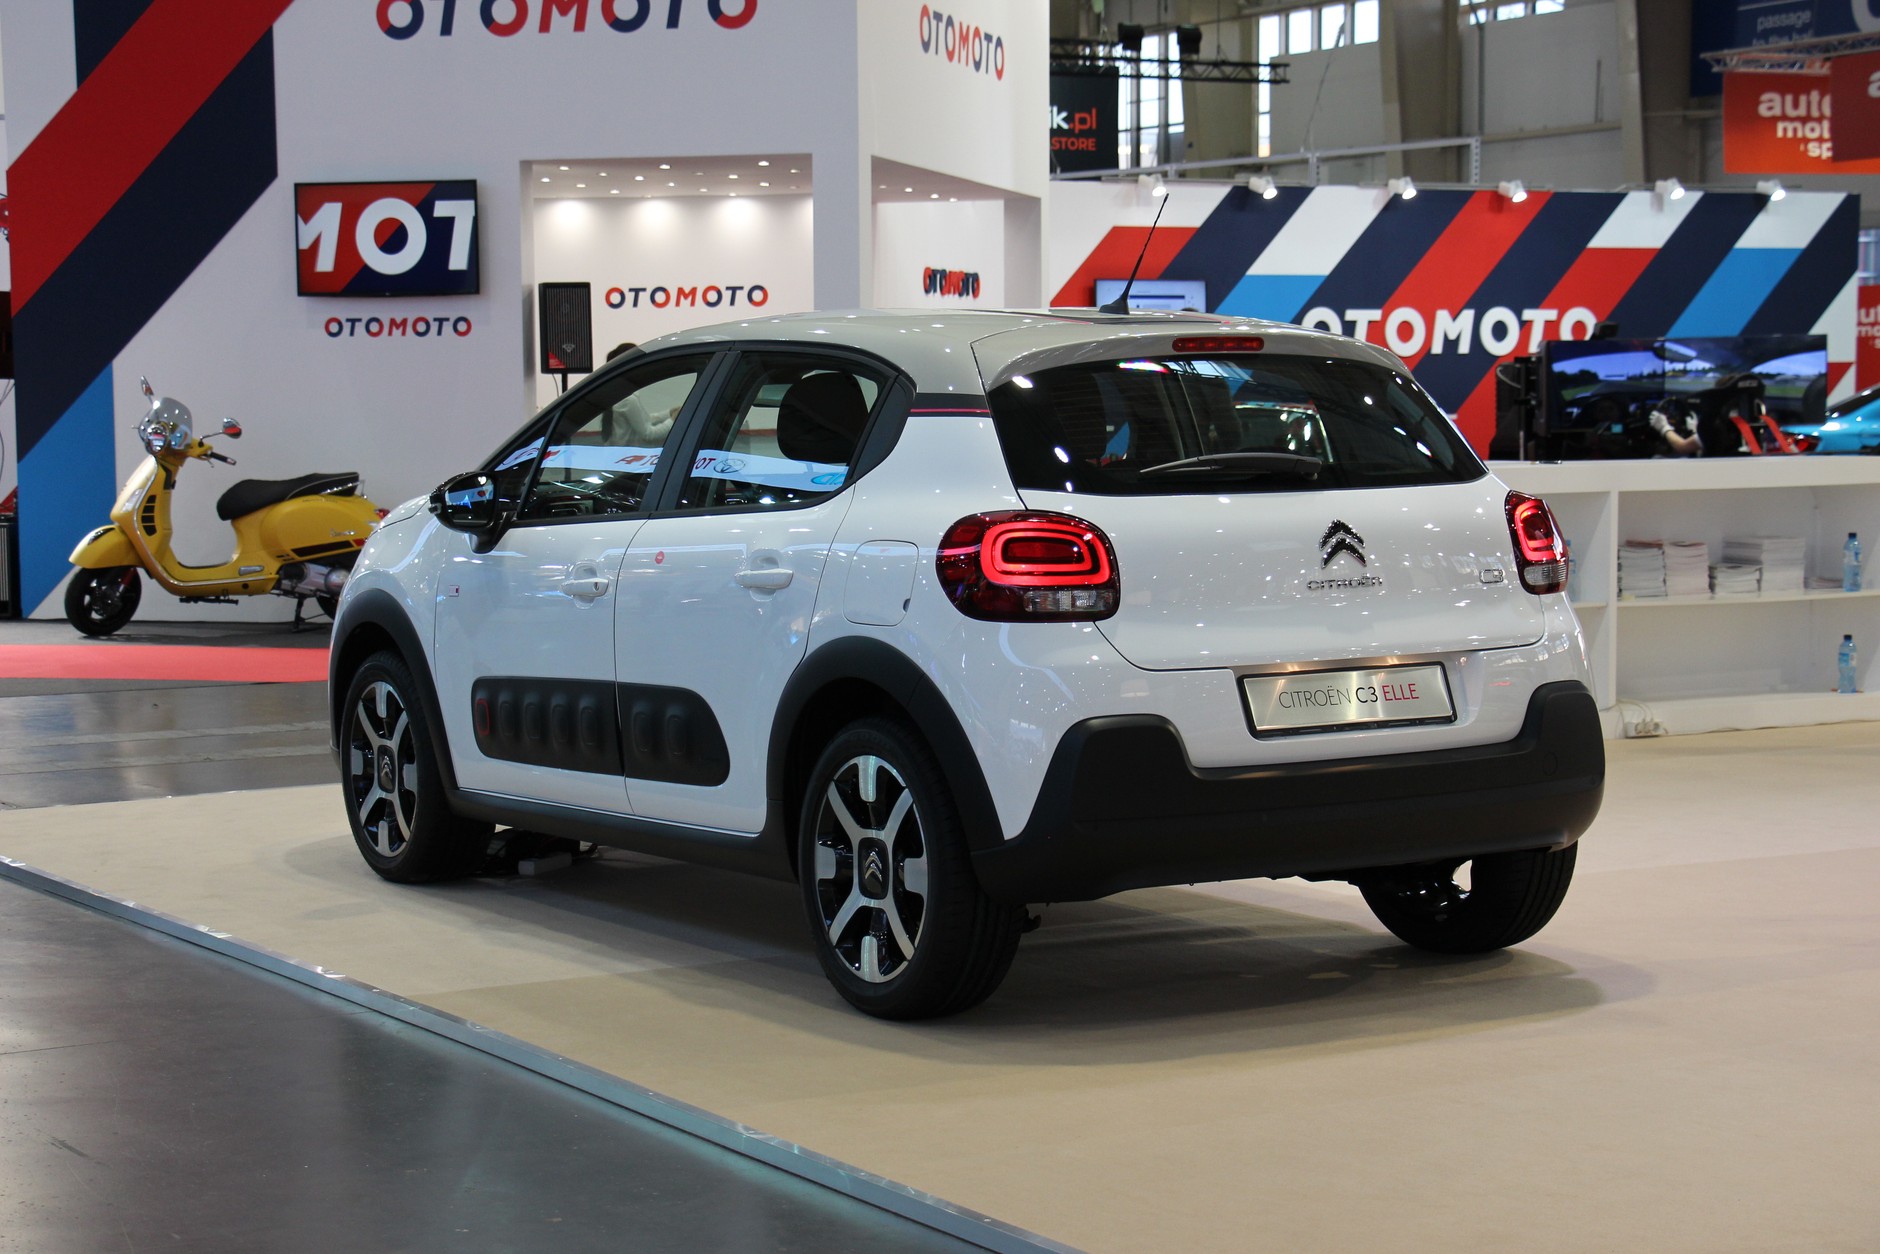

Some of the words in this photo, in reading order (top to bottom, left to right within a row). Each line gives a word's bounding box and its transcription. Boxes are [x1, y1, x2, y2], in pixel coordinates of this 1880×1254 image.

[919, 4, 1005, 81] OTOMOTO
[1051, 137, 1096, 151] STORE
[923, 266, 981, 300] OTOMOTO
[604, 284, 769, 309] OTOMOTO
[324, 316, 472, 338] OTOMOTO
[1300, 306, 1598, 357] OTOMOTO
[1278, 685, 1352, 708] CITROËN
[1355, 686, 1379, 704] C3
[1381, 683, 1420, 701] ELLE
